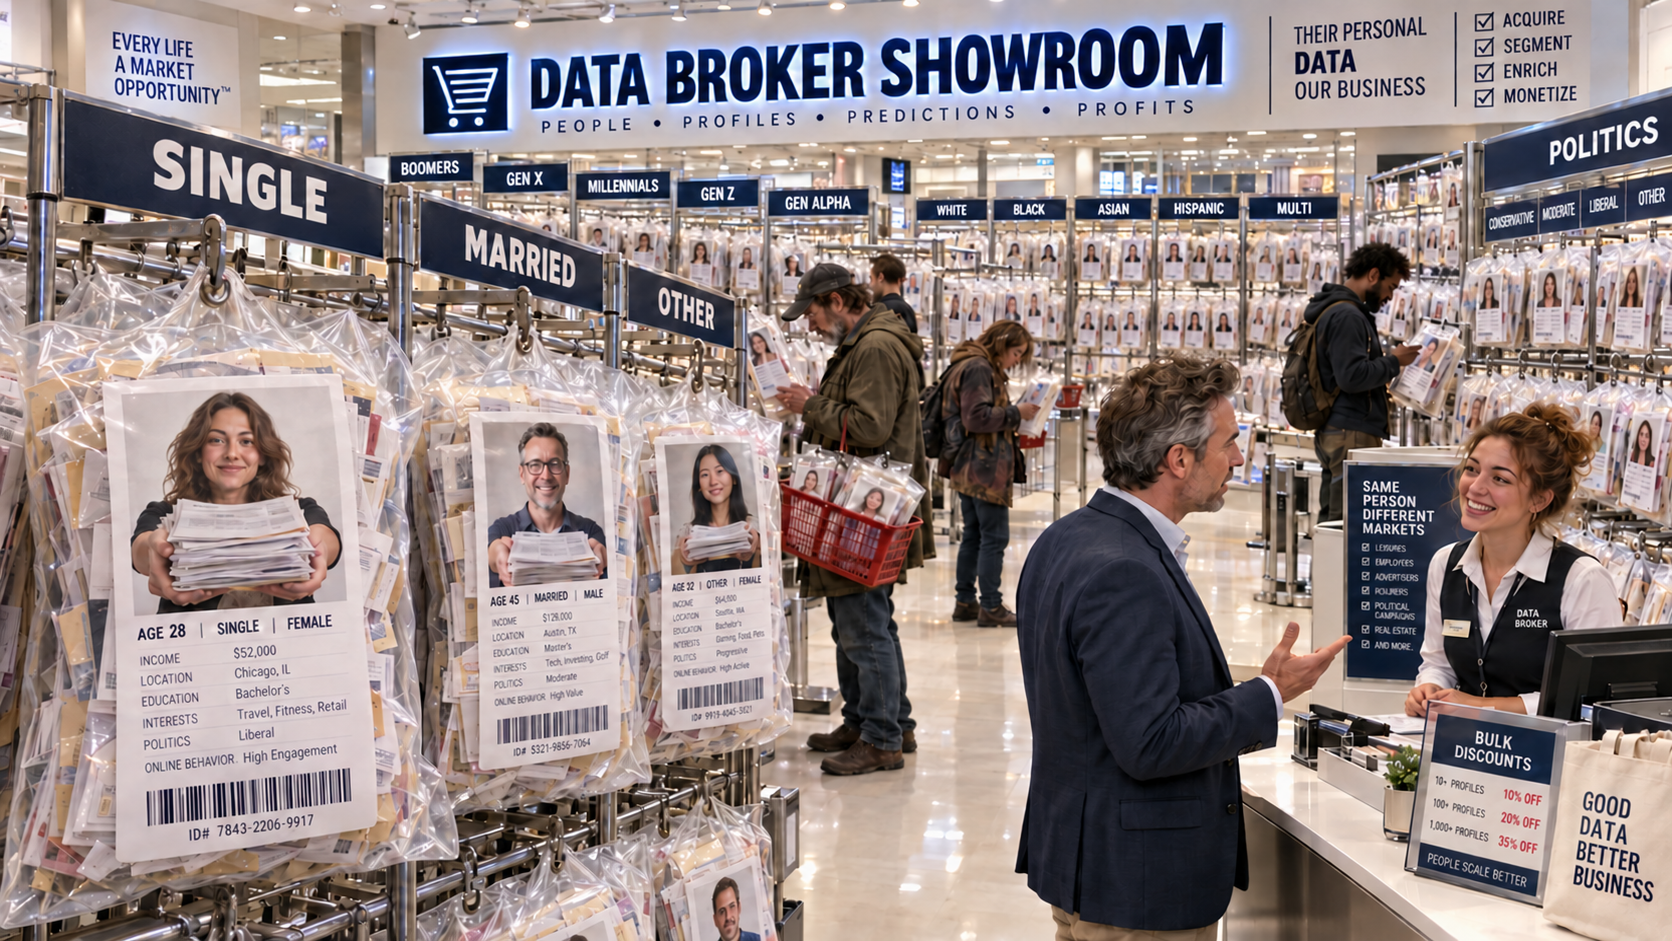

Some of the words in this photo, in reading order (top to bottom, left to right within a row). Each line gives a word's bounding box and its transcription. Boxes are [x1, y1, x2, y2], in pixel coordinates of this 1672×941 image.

[1503, 10, 1565, 28] ACQUIRE
[1294, 25, 1339, 45] THEIR
[1343, 17, 1427, 42] PERSONAL
[112, 31, 159, 55] EVERY
[164, 37, 194, 58] LIFE
[1504, 35, 1572, 54] SEGMENT
[115, 56, 126, 75] A
[131, 58, 194, 81] MARKET
[531, 53, 650, 110] DATA
[666, 41, 864, 105] BROKER
[881, 22, 1224, 98] SHOWROOM
[1294, 49, 1357, 75] DATA
[1504, 62, 1557, 79] ENRICH
[1294, 80, 1331, 100] OUR
[1338, 76, 1425, 98] BUSINESS
[1504, 85, 1577, 104] MONETIZE
[542, 118, 632, 134] PEOPLE
[683, 112, 796, 129] PROFILES
[848, 104, 1015, 124] PREDICTIONS
[1078, 99, 1194, 117] PROFITS
[1549, 116, 1659, 165] POLITICS
[401, 159, 459, 176] BOOMERS
[153, 138, 328, 225] SINGLE
[506, 172, 530, 186] GEN
[533, 171, 543, 186] X
[588, 178, 659, 193] MILLENNIALS
[700, 187, 725, 201] GEN
[726, 186, 735, 201] Z
[785, 196, 809, 210] GEN
[812, 195, 851, 210] ALPHA
[1639, 187, 1665, 206] OTHER
[936, 204, 967, 216] WHITE
[1013, 204, 1045, 215] BLACK
[1098, 203, 1130, 216] ASIAN
[1174, 202, 1224, 215] HISPANIC
[1277, 202, 1311, 215] MULTI
[1542, 202, 1575, 221] MODERATE
[1590, 196, 1618, 213] LIBERAL
[1489, 211, 1534, 230] CONSERVATIVE
[464, 224, 576, 288] MARRIED
[658, 287, 715, 331] OTHER
[1363, 481, 1400, 494] SAME
[1363, 495, 1416, 508] PERSON
[1363, 509, 1435, 522] DIFFERENT
[1363, 523, 1425, 536] MARKETS
[672, 583, 685, 592] AGE
[707, 579, 728, 589] OTHER
[739, 575, 761, 585] FEMALE
[490, 596, 507, 607] AGE
[510, 595, 520, 605] 45
[535, 591, 569, 603] MARRIED
[584, 589, 603, 600] MALE
[673, 599, 694, 608] INCOME
[1375, 602, 1410, 611] POLITICAL
[492, 617, 517, 627] INCOME
[673, 612, 700, 622] LOCATION
[1517, 609, 1540, 618] DATA
[138, 627, 164, 641] AGE
[170, 624, 186, 638] 28
[218, 620, 259, 636] SINGLE
[288, 615, 332, 630] FEMALE
[673, 625, 702, 635] EDUCATION
[1375, 626, 1391, 635] REAL
[1393, 627, 1417, 636] ESTATE
[1515, 619, 1548, 628] BROKER
[493, 632, 524, 642] LOCATION
[568, 627, 577, 635] TX
[493, 647, 530, 658] EDUCATION
[1375, 641, 1390, 649] AND
[140, 654, 180, 666] INCOME
[234, 645, 277, 660] $52,000
[494, 662, 527, 673] INTERESTS
[596, 651, 609, 661] Golf
[674, 653, 697, 663] POLITICS
[141, 672, 193, 687] LOCATION
[235, 666, 279, 680] Chicago,
[282, 665, 291, 675] IL
[494, 679, 523, 689] POLITICS
[546, 673, 577, 683] Moderate
[674, 669, 691, 678] ONLINE
[142, 693, 199, 707] EDUCATION
[236, 685, 290, 699] Bachelor's
[495, 697, 516, 707] ONLINE
[550, 691, 565, 701] High
[566, 689, 584, 697] Value
[143, 714, 198, 729] INTERESTS
[237, 707, 273, 720] Travel,
[276, 703, 315, 717] Fitness,
[318, 700, 347, 712] Retail
[144, 736, 191, 750] POLITICS
[239, 727, 275, 741] Liberal
[1475, 731, 1513, 750] BULK
[145, 759, 182, 774] ONLINE
[243, 751, 268, 764] High
[271, 744, 338, 762] Engagement
[513, 748, 526, 757] ID#
[1455, 745, 1532, 772] DISCOUNTS
[1451, 779, 1485, 795] PROFILES
[1504, 789, 1522, 802] 10%
[1524, 793, 1543, 806] OFF
[1434, 798, 1449, 809] 100+
[1453, 803, 1486, 819] PROFILES
[1501, 812, 1520, 826] 20%
[1523, 817, 1541, 830] OFF
[1583, 791, 1631, 819] GOOD
[189, 827, 210, 841] ID#
[218, 814, 314, 837] 7843-2206-9917
[1580, 816, 1627, 845] DATA
[1455, 826, 1489, 842] PROFILES
[1498, 835, 1518, 850] 35%
[1520, 840, 1538, 855] OFF
[1576, 841, 1640, 874] BETTER
[1428, 853, 1460, 871] PEOPLE
[1462, 862, 1490, 878] SCALE
[1493, 869, 1527, 888] BETTER
[1573, 865, 1654, 902] BUSINESS
